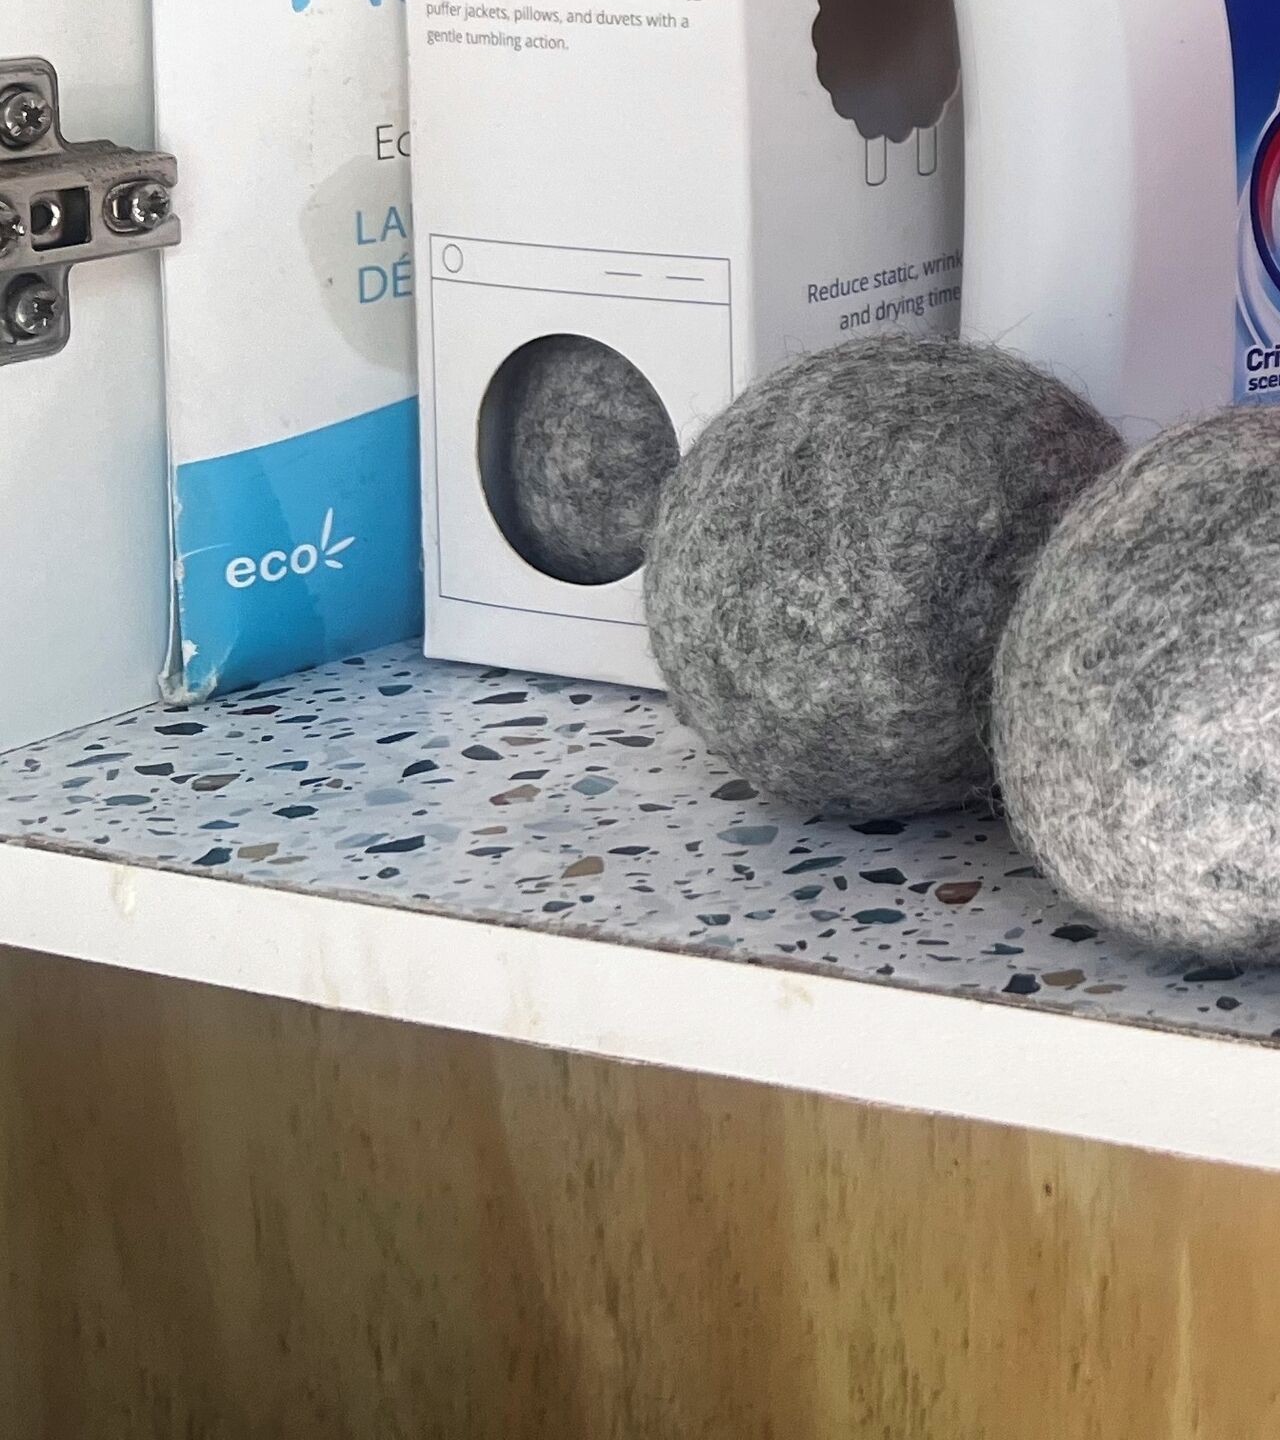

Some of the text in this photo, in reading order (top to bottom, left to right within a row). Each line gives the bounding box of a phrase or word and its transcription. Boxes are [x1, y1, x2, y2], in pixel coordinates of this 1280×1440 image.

[426, 2, 690, 30] puffer jackets, pillows, and duvets with a
[427, 28, 570, 52] gentle tumbling action.
[358, 252, 413, 304] DÉ
[807, 275, 870, 304] Reduce
[873, 262, 919, 289] static,
[839, 304, 871, 330] and
[875, 294, 925, 323] drying
[224, 541, 319, 589] eco
